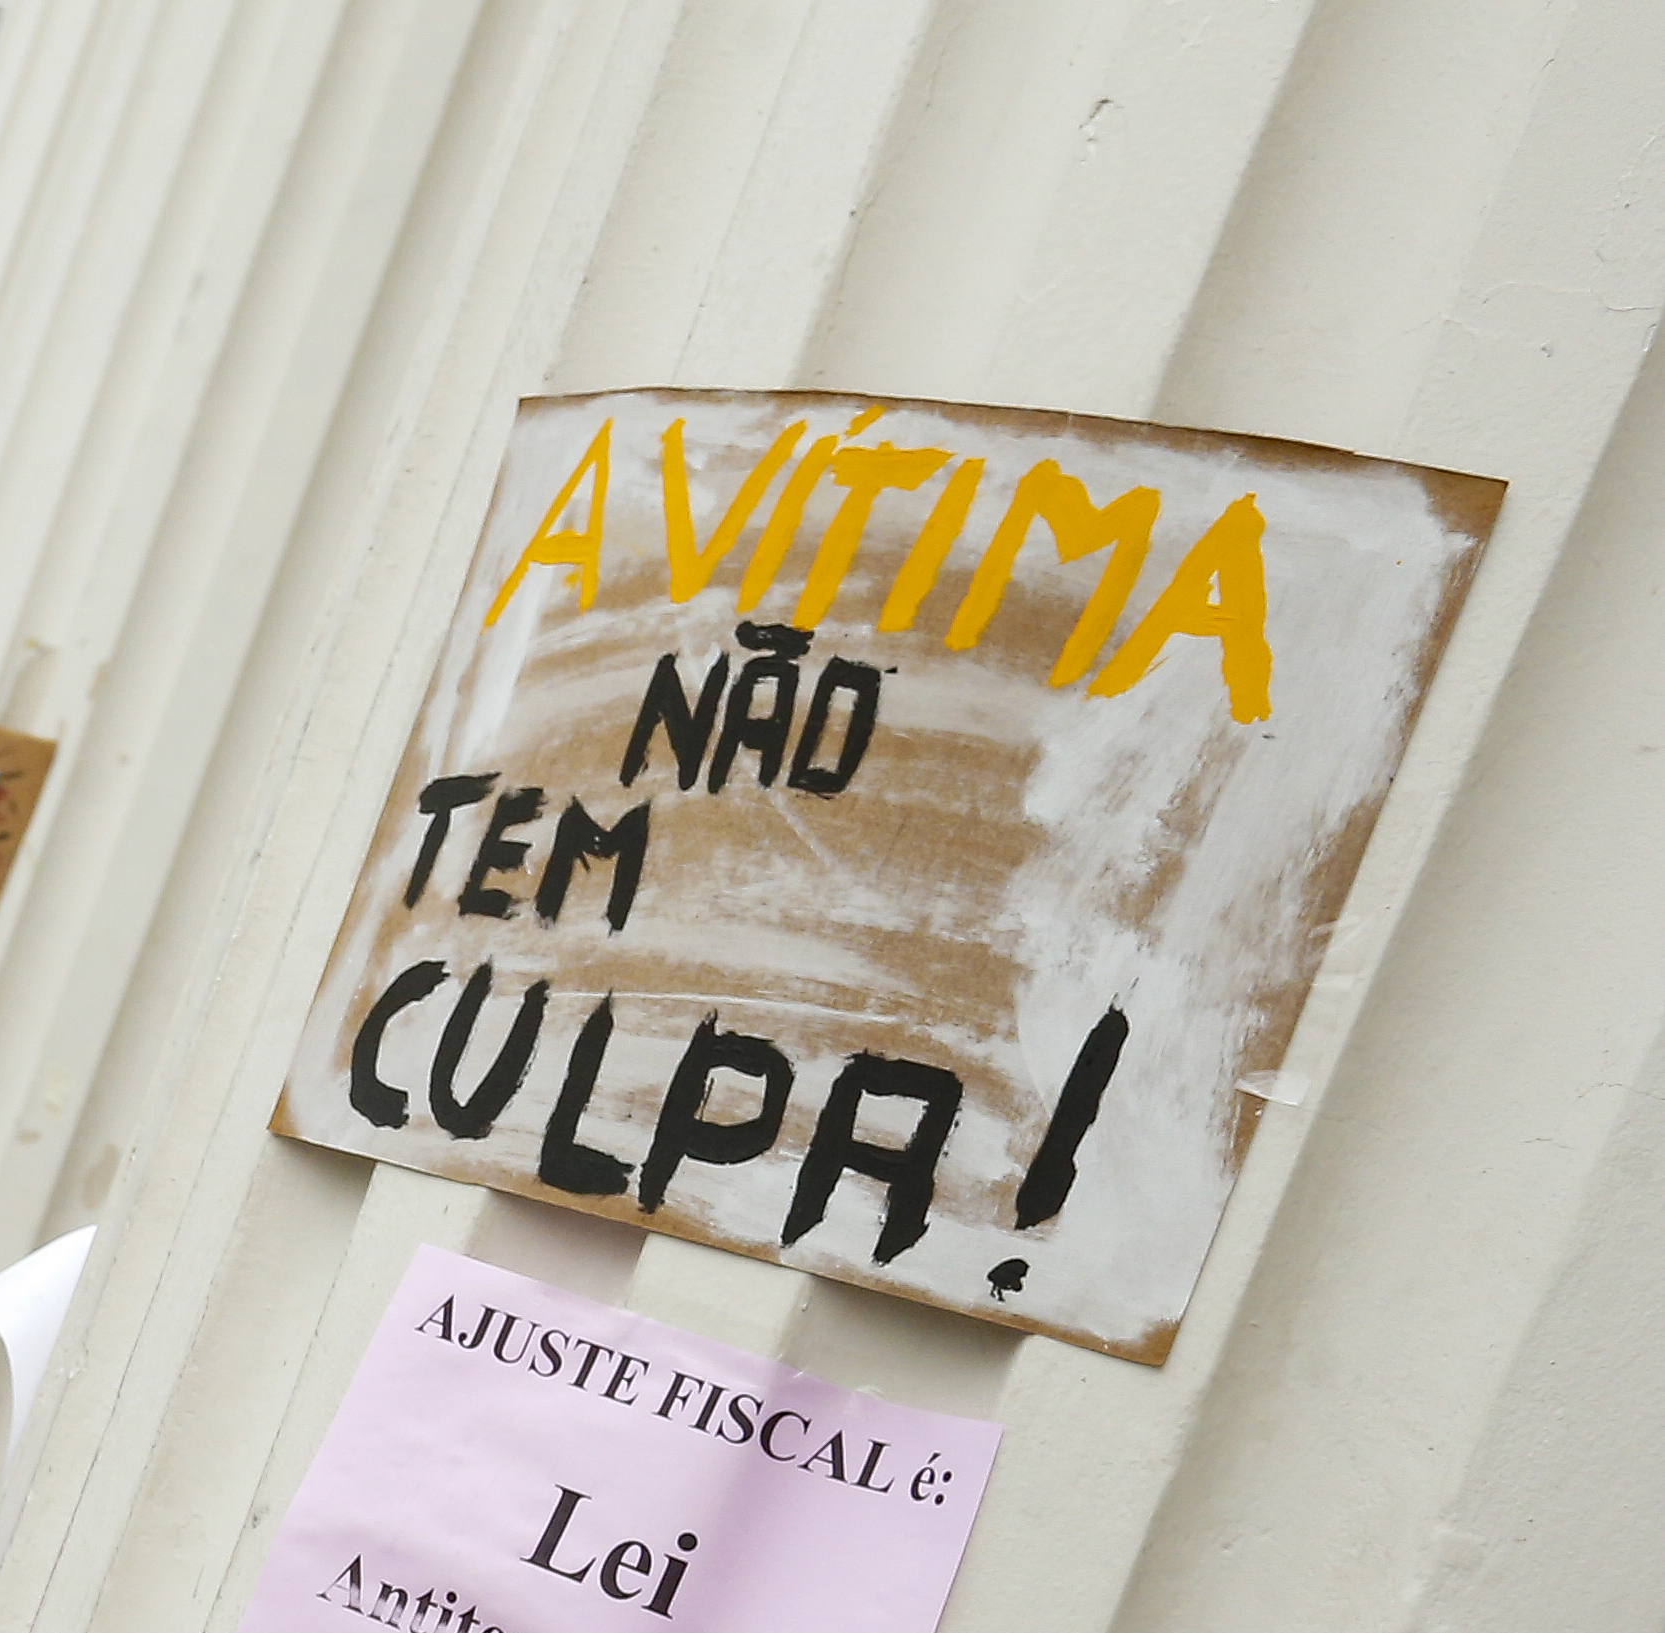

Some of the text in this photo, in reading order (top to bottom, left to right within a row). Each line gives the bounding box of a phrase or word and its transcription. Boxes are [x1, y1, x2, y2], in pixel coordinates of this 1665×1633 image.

[482, 404, 1274, 726] A VÍTIMA
[620, 621, 898, 798] NÃO
[403, 770, 652, 936] TEM
[347, 957, 1132, 1303] CULPA!
[415, 1293, 954, 1506] AJUSTE FISCAL é:
[519, 1483, 700, 1620] Lei
